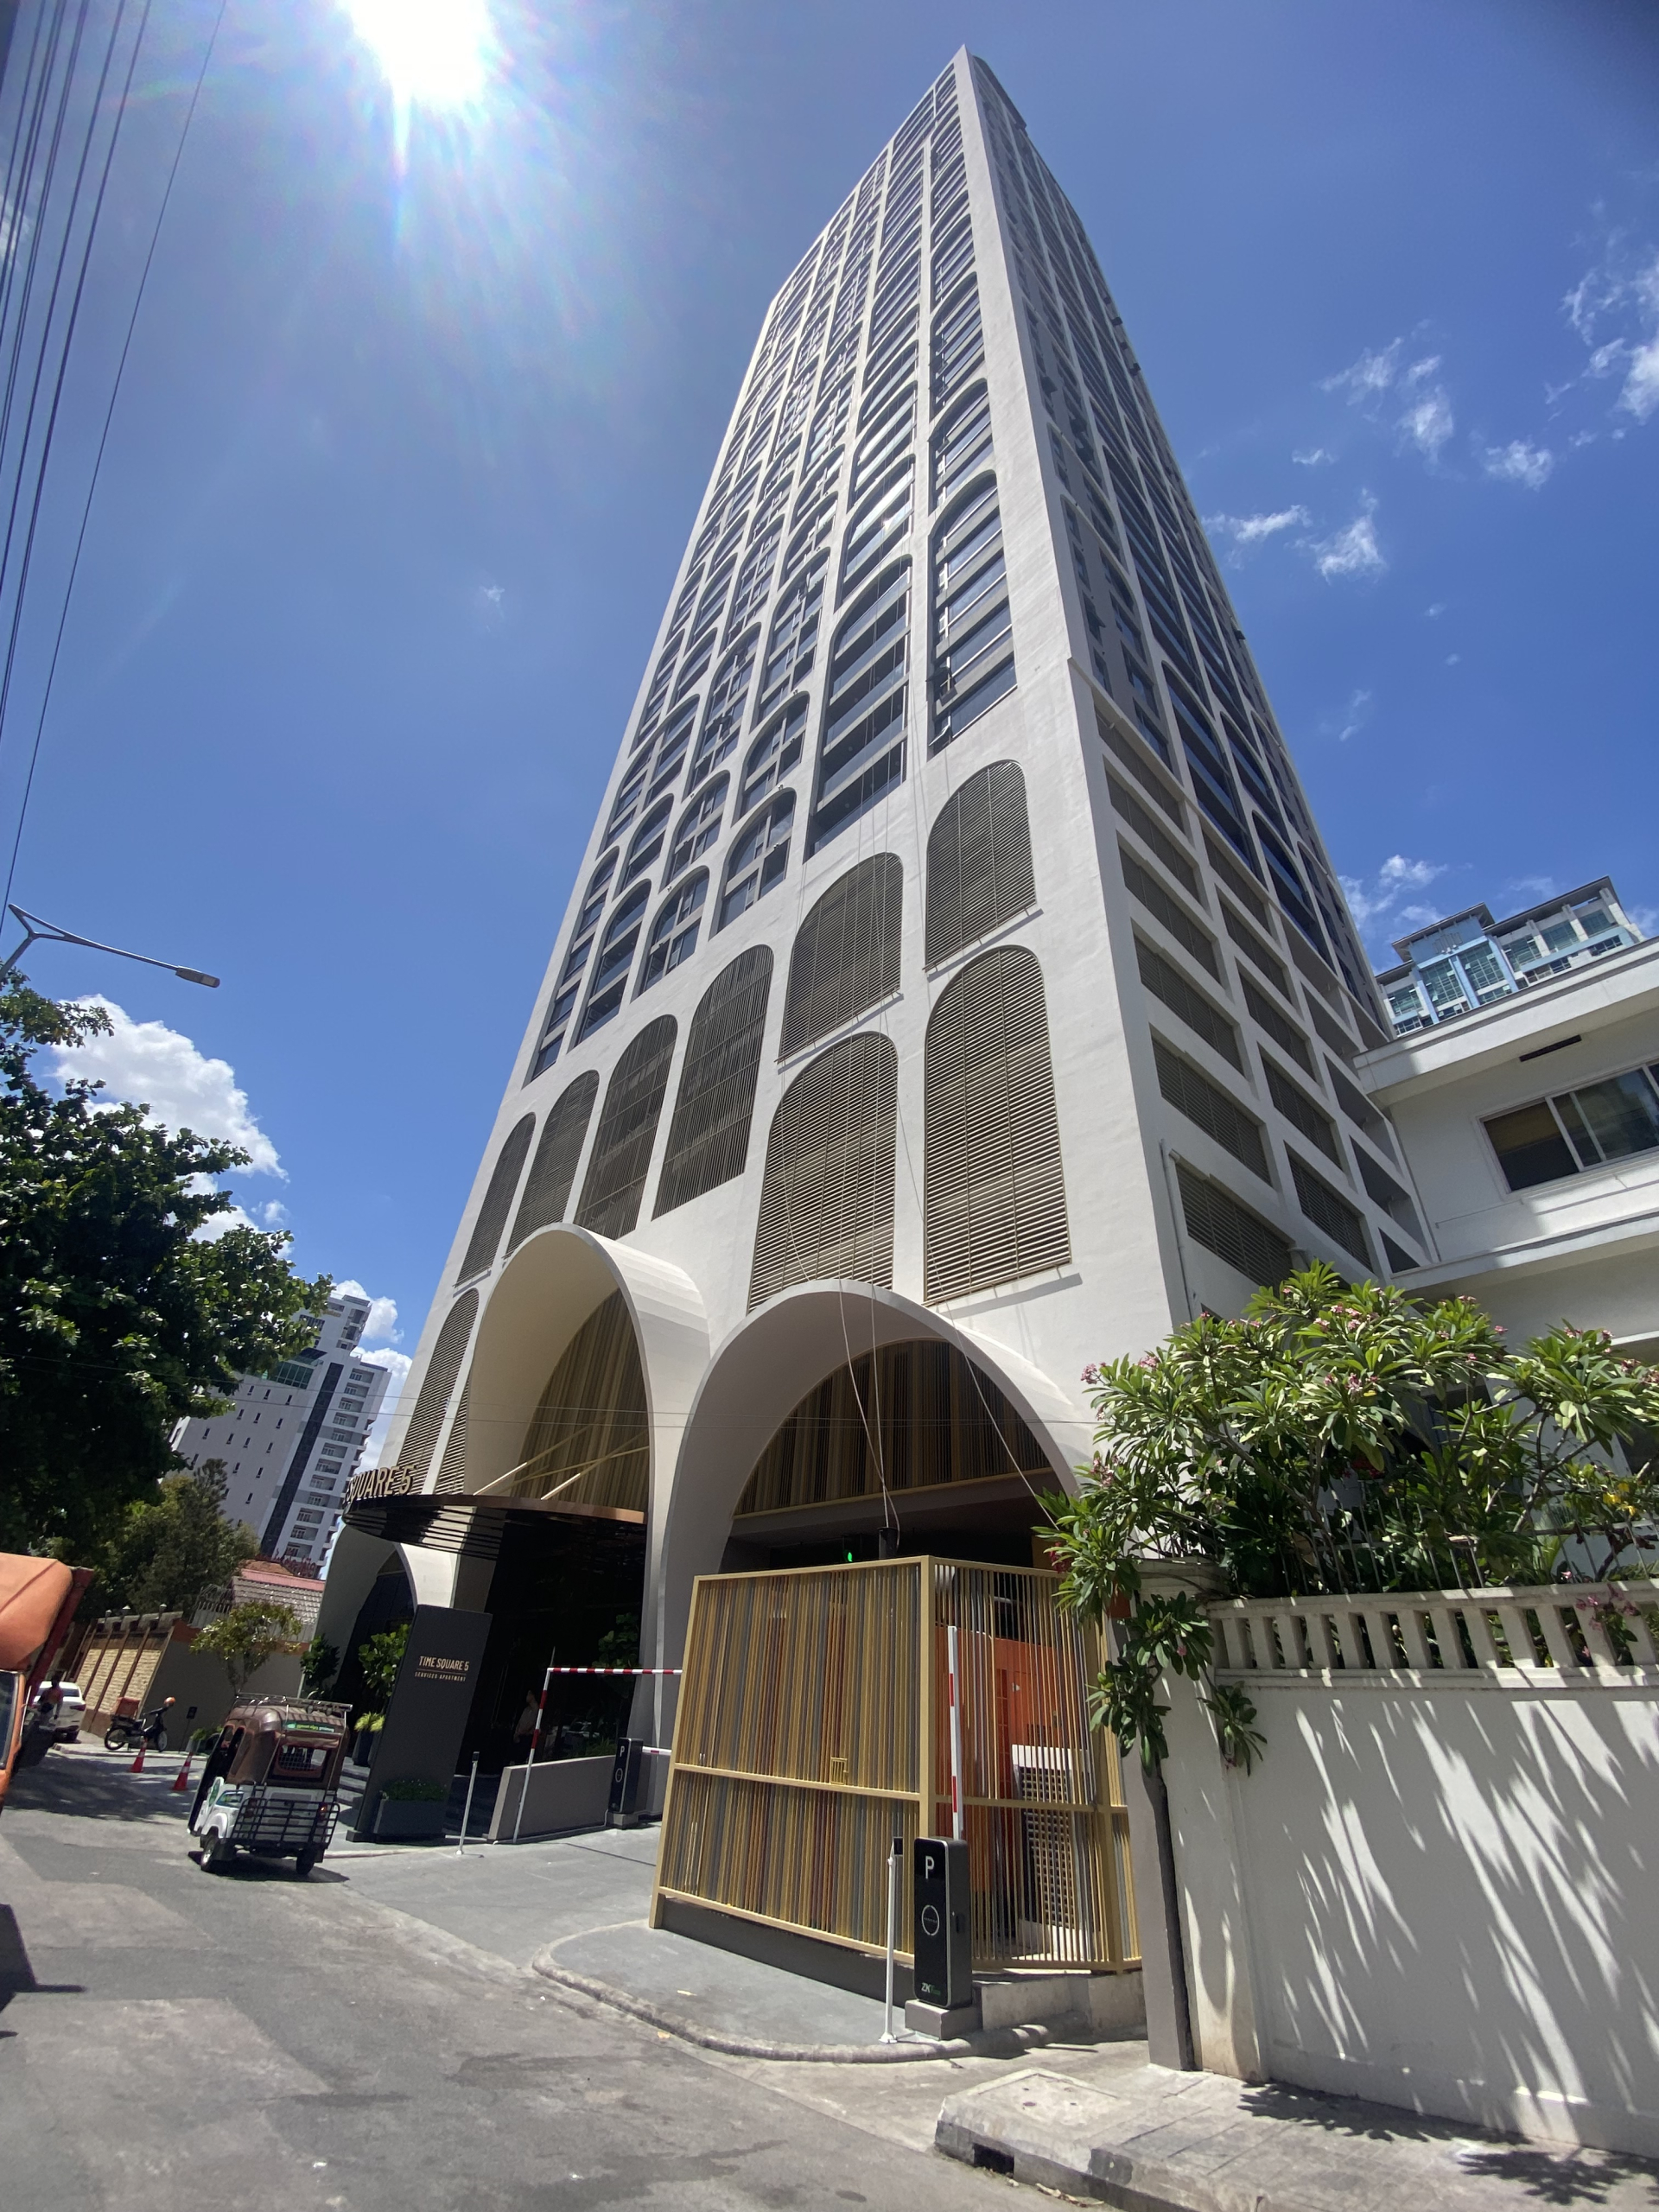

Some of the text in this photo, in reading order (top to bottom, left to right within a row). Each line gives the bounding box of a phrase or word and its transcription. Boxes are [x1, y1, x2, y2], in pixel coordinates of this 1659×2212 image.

[346, 1465, 414, 1503] SQUARE 5
[419, 1656, 470, 1671] TIME SQUARE 5
[620, 1745, 625, 1758] P
[925, 1855, 935, 1879] P
